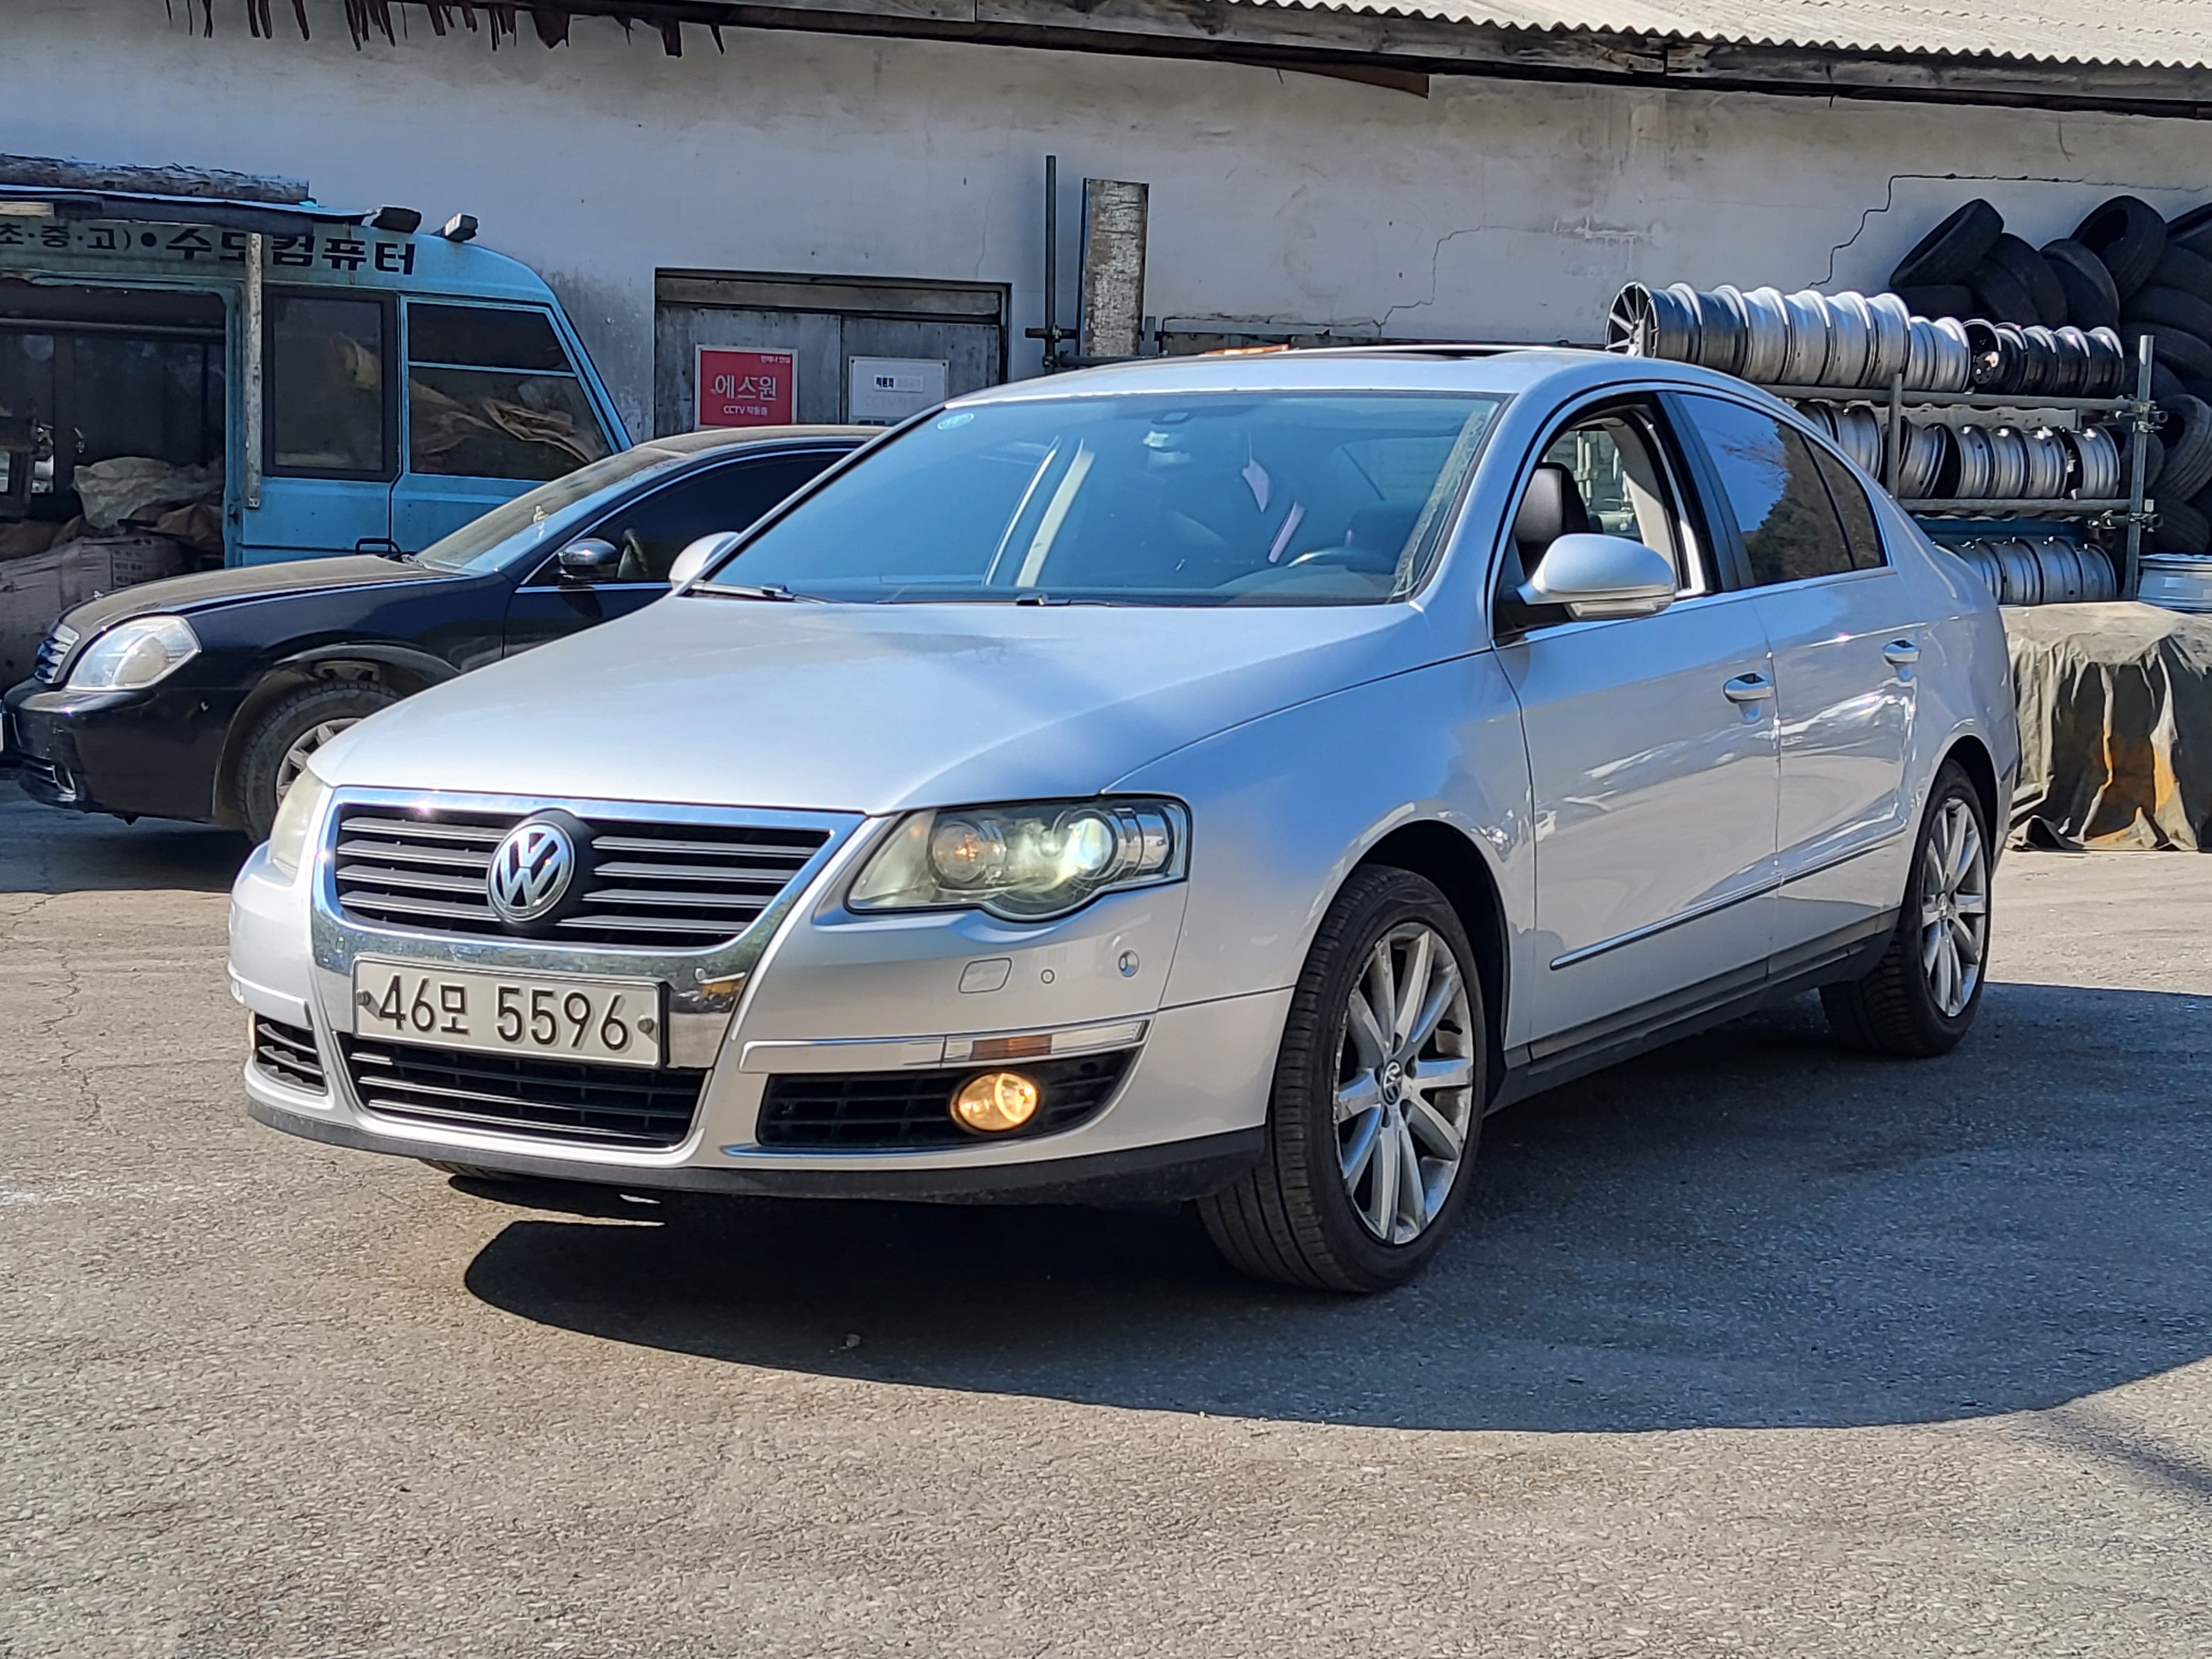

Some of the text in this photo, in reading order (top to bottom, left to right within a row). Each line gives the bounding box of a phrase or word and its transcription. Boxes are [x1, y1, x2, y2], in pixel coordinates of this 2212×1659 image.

[715, 374, 776, 401] 에스원
[723, 405, 745, 414] CCTV
[380, 974, 629, 1051] 46모 5596
